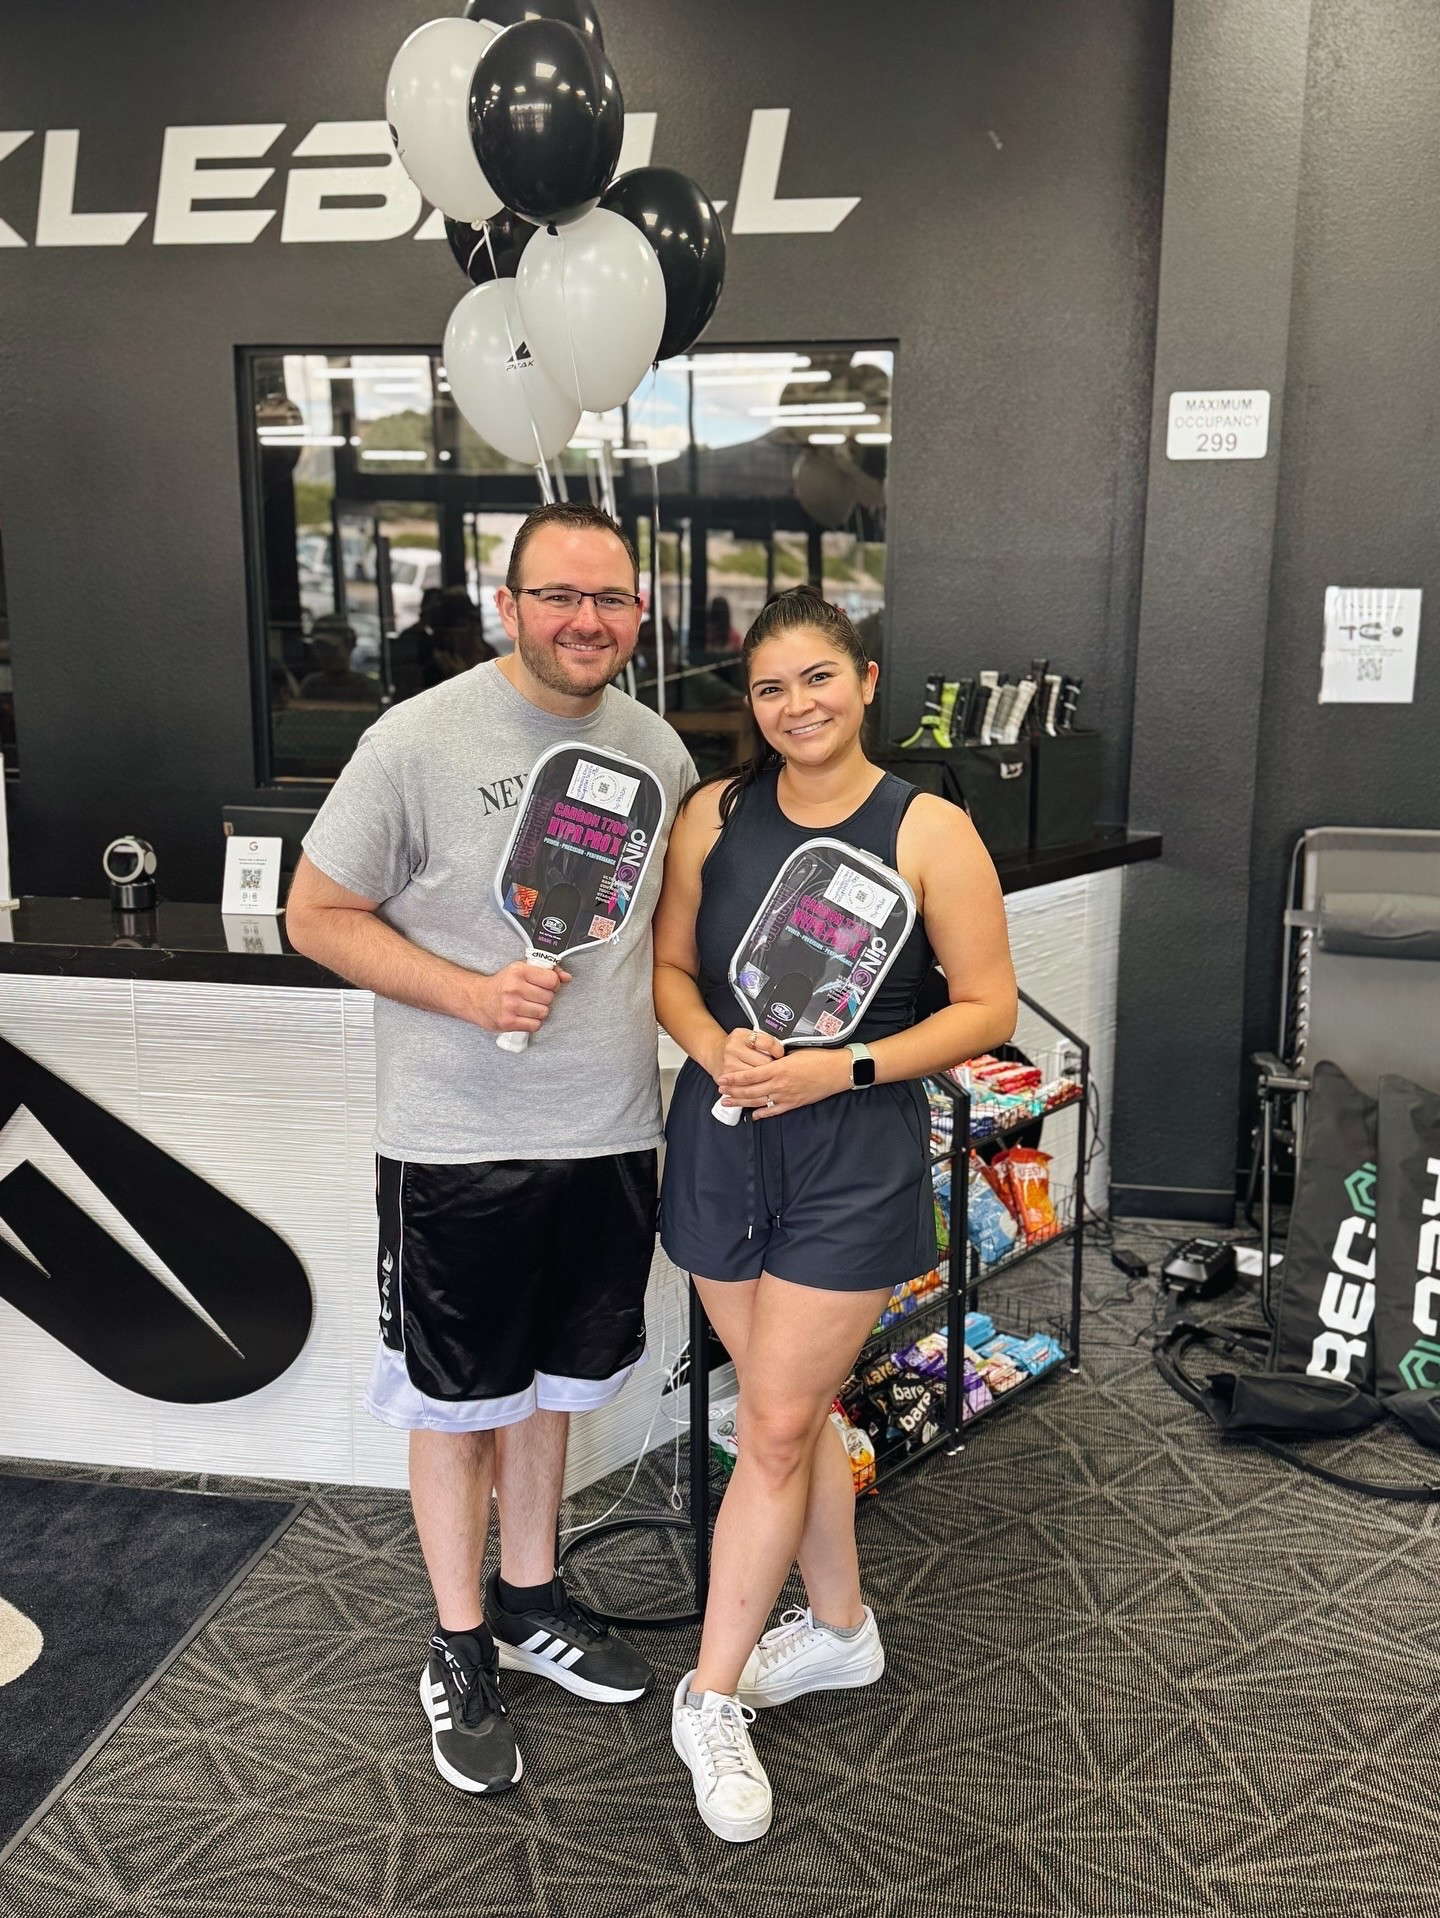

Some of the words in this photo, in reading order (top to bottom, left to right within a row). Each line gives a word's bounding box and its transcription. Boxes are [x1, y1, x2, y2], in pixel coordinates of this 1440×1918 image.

[0, 108, 861, 248] LEBL
[1174, 415, 1262, 428] OCCUPANCY
[1185, 399, 1252, 411] MAXIMUM
[1196, 433, 1237, 452] 299
[477, 773, 529, 816] NE
[546, 816, 584, 844] HYPR
[581, 827, 612, 853] PRO
[608, 836, 622, 856] X
[900, 1392, 931, 1432] bare
